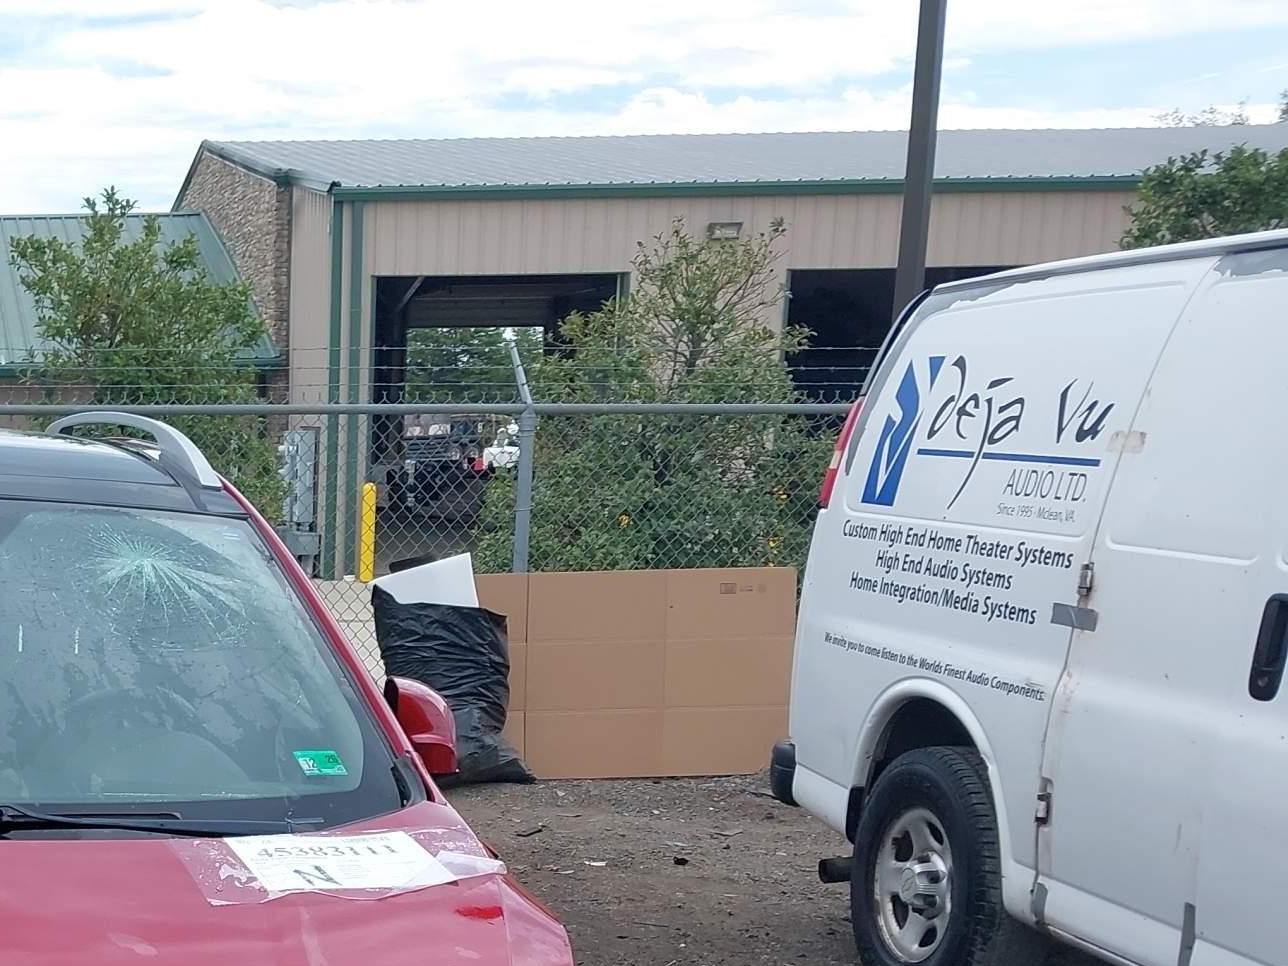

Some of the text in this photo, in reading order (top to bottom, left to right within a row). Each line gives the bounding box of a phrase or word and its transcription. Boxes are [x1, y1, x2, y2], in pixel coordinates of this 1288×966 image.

[1056, 378, 1114, 444] Vu
[1002, 468, 1087, 502] AUDIO LTD.
[997, 502, 1015, 516] Since
[1016, 504, 1033, 518] 1995
[843, 519, 1074, 568] Custom High End Home Theater Systems
[875, 549, 1013, 590] High End Audio Systems
[849, 571, 1037, 625] Home Integration/Media Systems
[824, 631, 833, 643] We
[846, 640, 858, 652] you
[857, 643, 865, 653] to
[864, 645, 881, 658] come
[880, 647, 899, 663] listen
[898, 653, 906, 665] to
[906, 655, 918, 668] the
[918, 656, 943, 674] Worlds
[942, 663, 966, 681] Finest
[965, 669, 990, 687] Audio
[257, 844, 399, 858] 45383111
[293, 864, 343, 887] N
